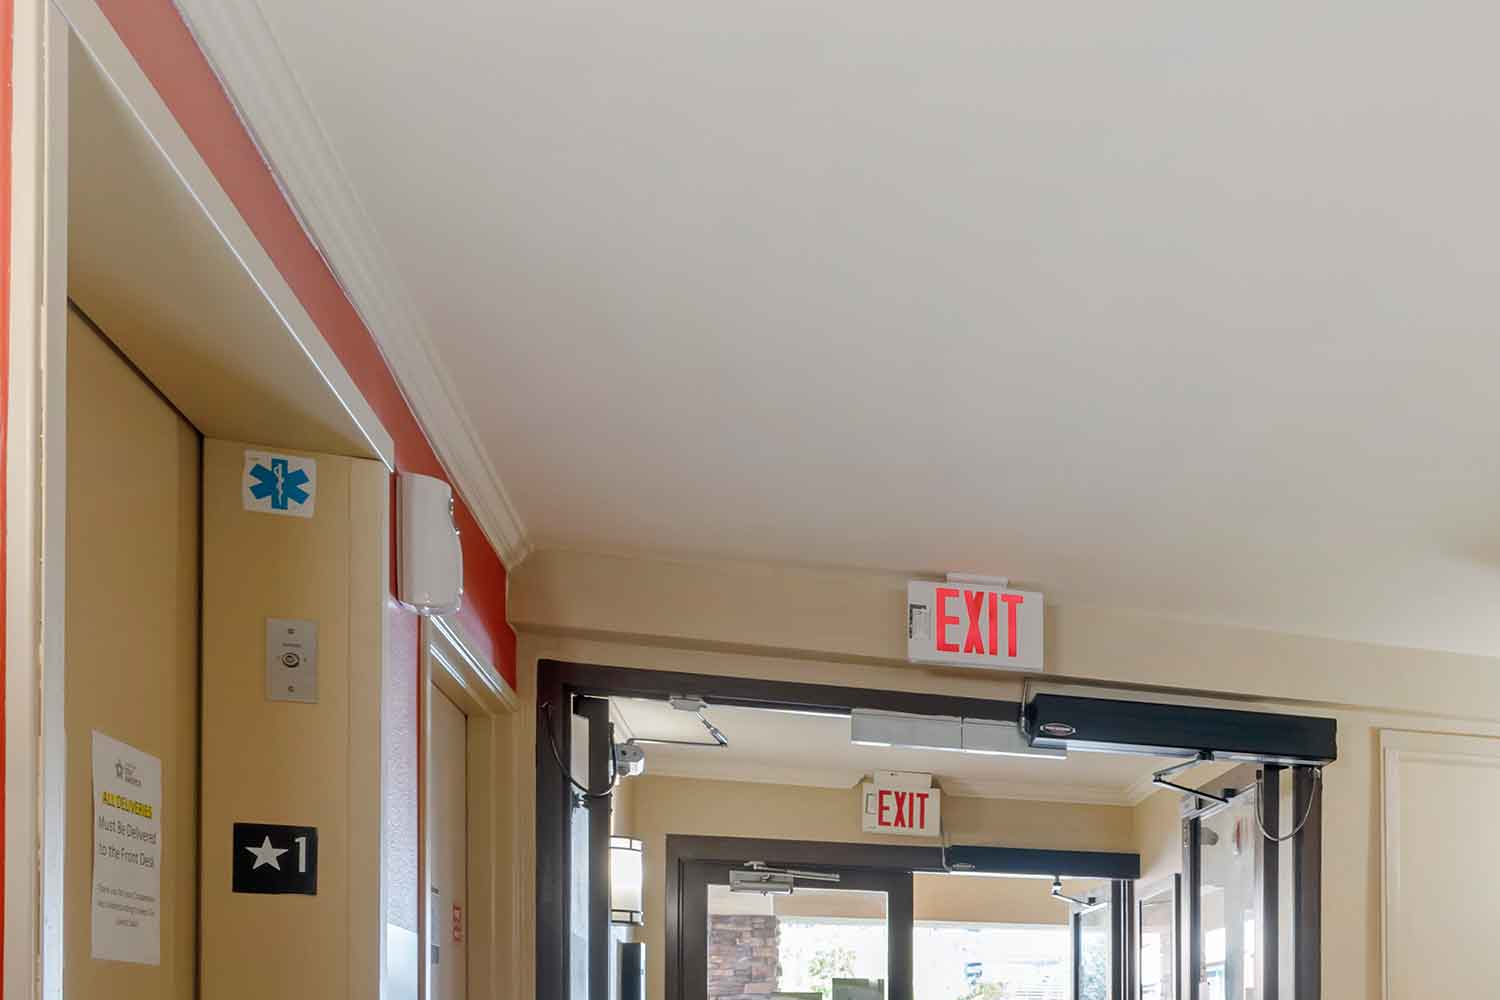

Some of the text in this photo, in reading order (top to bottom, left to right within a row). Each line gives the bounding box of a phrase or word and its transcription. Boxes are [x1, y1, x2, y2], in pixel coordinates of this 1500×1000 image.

[935, 587, 1024, 657] EXIT
[878, 789, 929, 829] EXIT
[98, 815, 157, 845] Must Be Delivered
[98, 842, 108, 857] to
[108, 844, 120, 861] the
[121, 848, 138, 865] Front
[294, 836, 307, 873] 1
